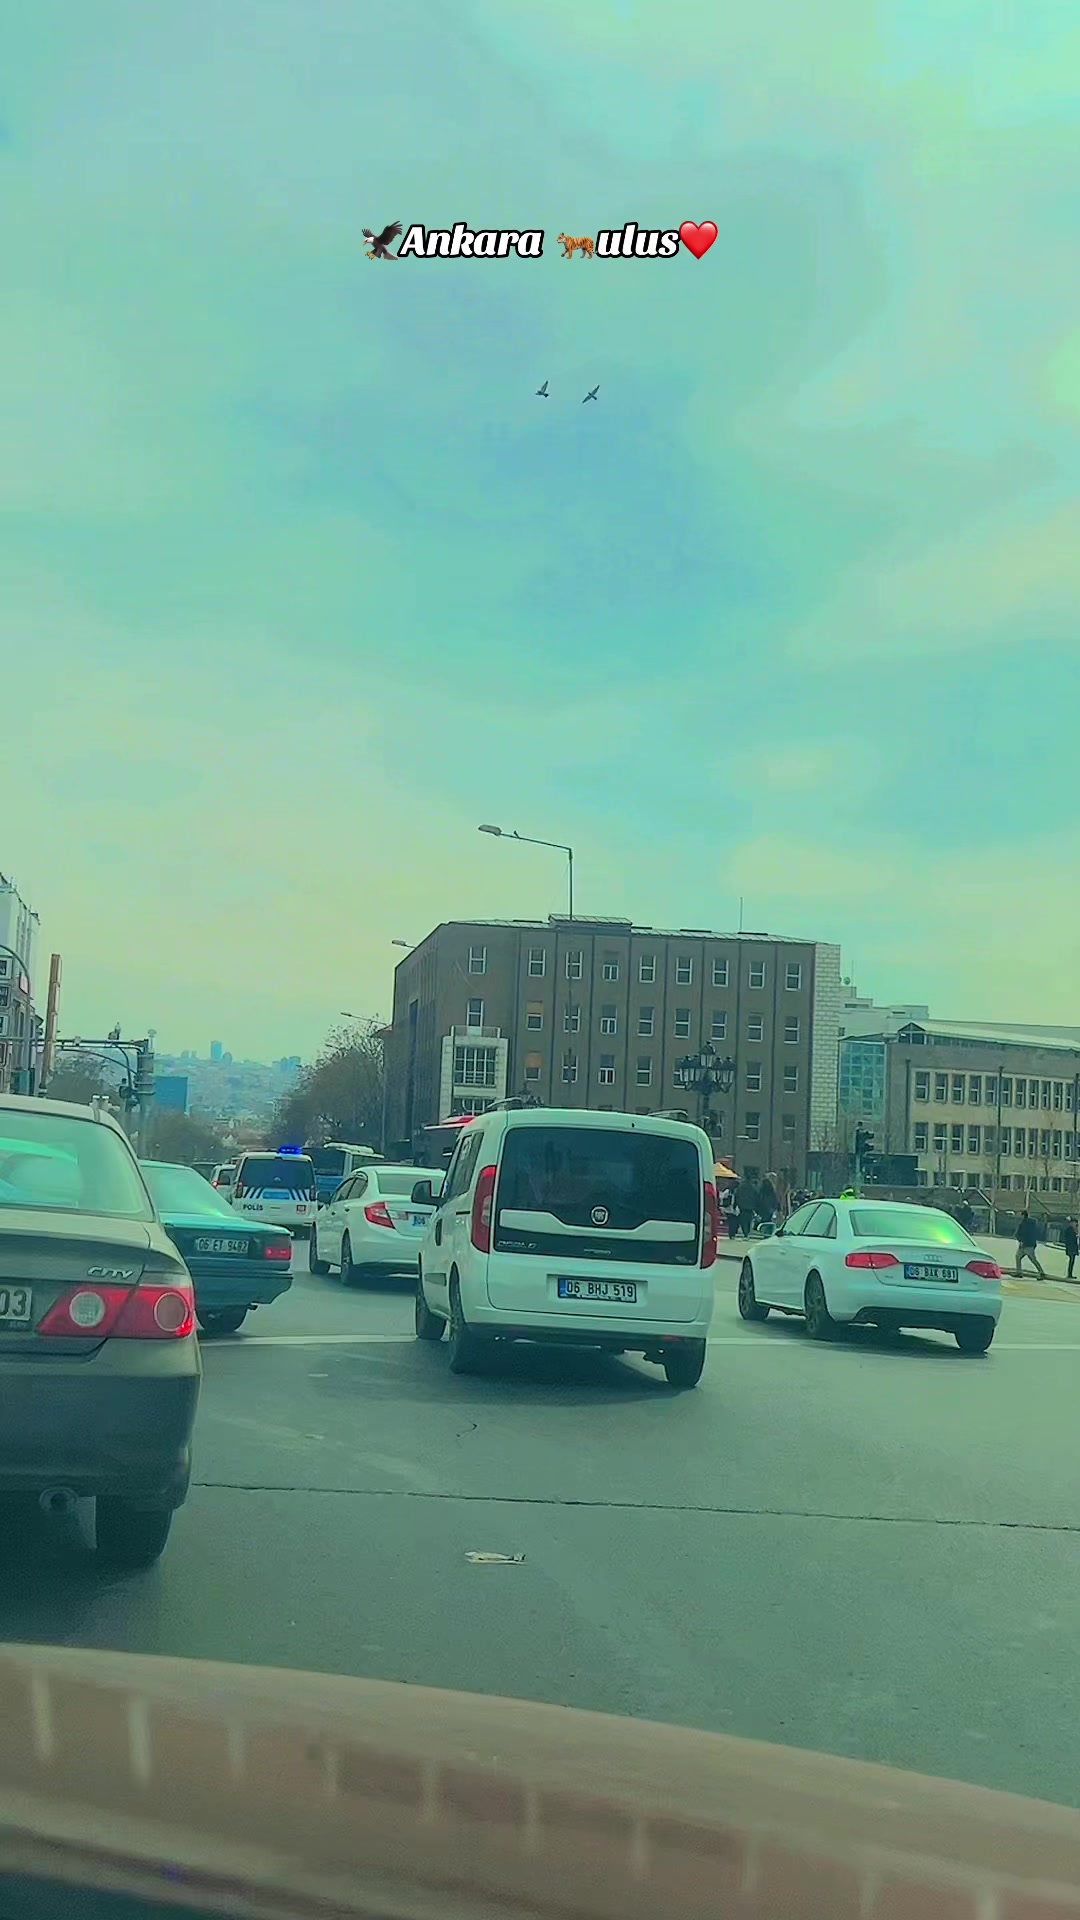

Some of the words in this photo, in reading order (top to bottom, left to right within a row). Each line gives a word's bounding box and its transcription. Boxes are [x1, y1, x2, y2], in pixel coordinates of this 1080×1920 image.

[199, 1239, 210, 1250] 06
[213, 1239, 224, 1251] ET
[88, 1266, 133, 1278] CITY
[925, 1266, 939, 1277] BAK
[567, 1281, 580, 1293] 06
[588, 1282, 608, 1295] BHJ
[614, 1284, 633, 1297] 519
